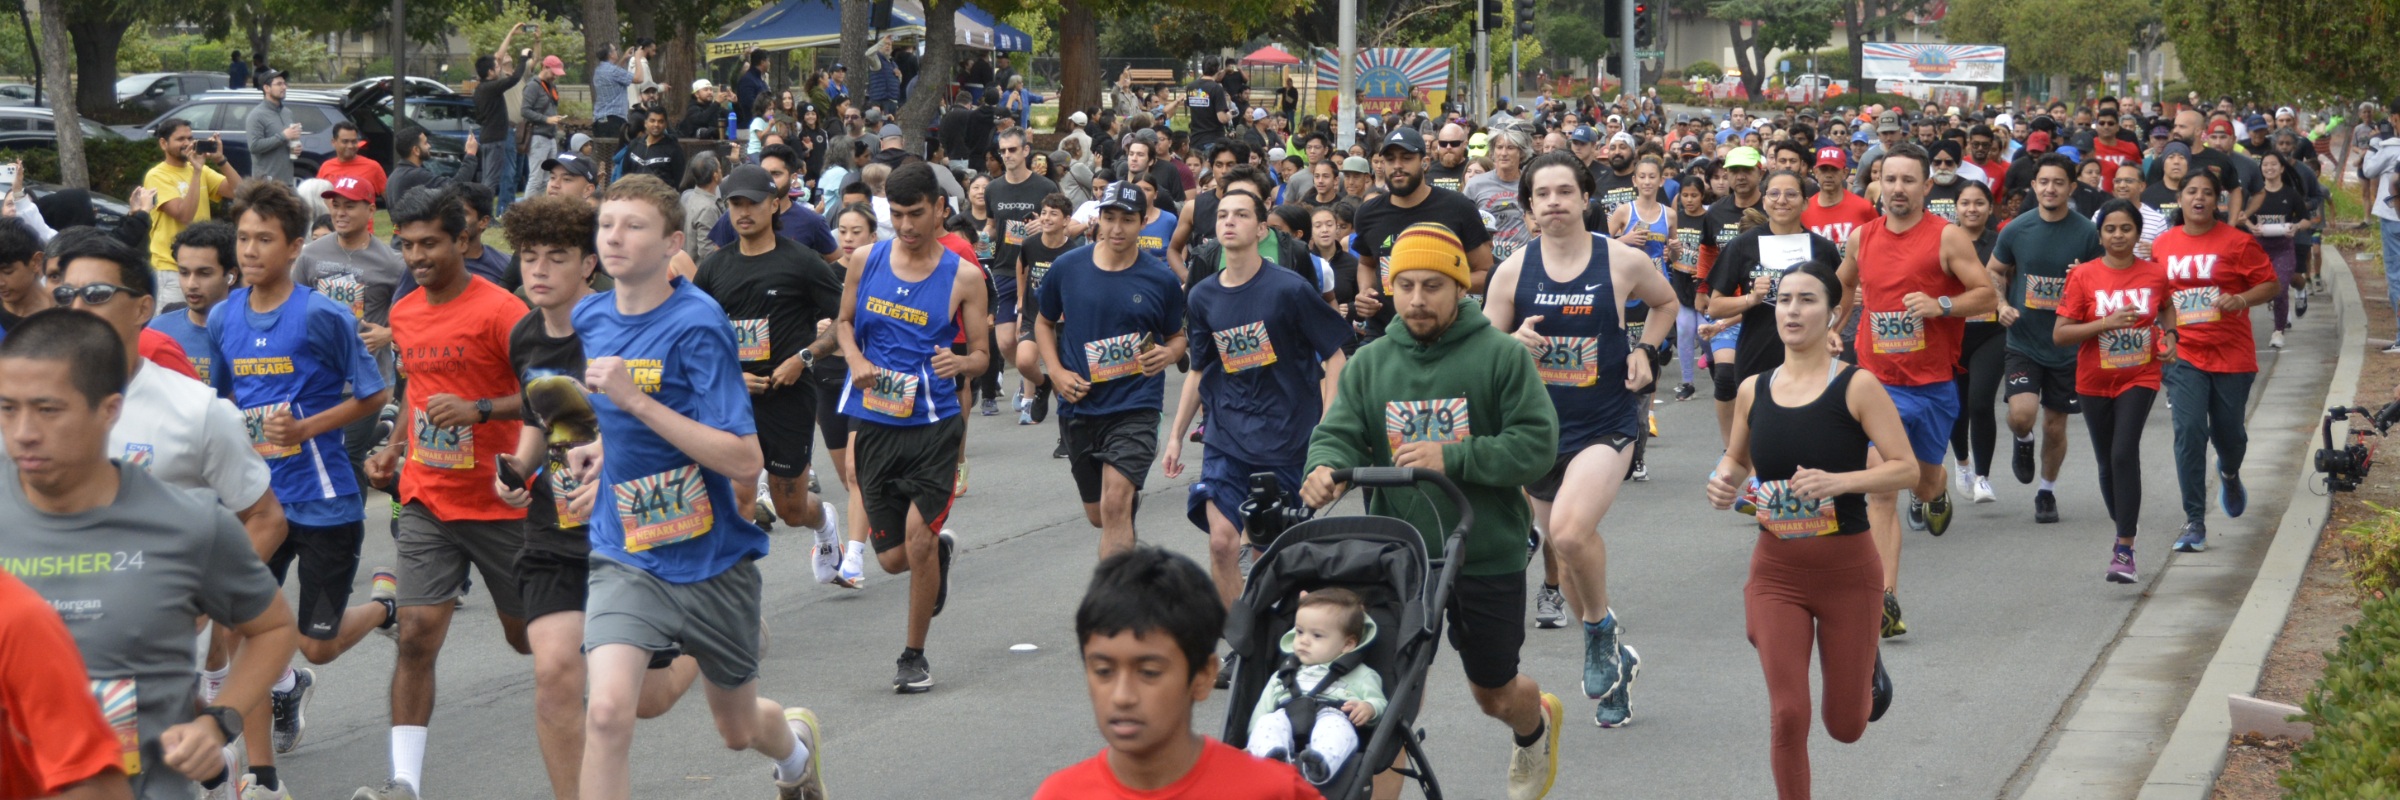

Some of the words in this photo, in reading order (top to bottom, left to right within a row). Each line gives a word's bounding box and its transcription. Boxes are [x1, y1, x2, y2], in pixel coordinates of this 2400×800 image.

[1967, 62, 1995, 71] FINISH
[1970, 70, 1990, 79] LINE
[1363, 101, 1392, 110] WARK
[997, 202, 1035, 211] Shopagon
[1011, 225, 1029, 236] 46
[1811, 222, 1853, 243] MV
[1491, 244, 1512, 257] 08
[2167, 254, 2217, 280] MV
[325, 285, 355, 303] 188
[2033, 281, 2064, 297] 437
[1534, 293, 1595, 306] ILLINOIS
[2095, 287, 2152, 316] MV
[2179, 291, 2211, 310] 276
[866, 301, 928, 327] COUGARS
[868, 296, 894, 310] NEWARK
[894, 302, 929, 318] MEMORIAL
[1562, 305, 1593, 315] ELITE
[1878, 316, 1914, 336] 556
[735, 324, 758, 345] 01
[1222, 329, 1260, 354] 265
[1878, 340, 1902, 348] NEWARK
[1902, 339, 1917, 347] MILE
[2108, 332, 2142, 352] 280
[404, 346, 464, 357] RUNAY
[748, 348, 763, 357] MILE
[1095, 340, 1133, 364] 268
[1539, 343, 1582, 365] 251
[2108, 355, 2132, 363] NEWARK
[2132, 353, 2145, 361] MILE
[233, 357, 260, 365] NEWARK
[261, 356, 291, 364] MEMORIAL
[405, 360, 467, 372] UNDATION
[624, 358, 663, 368] MORIAL
[1229, 356, 1253, 367] NEWARK
[1253, 353, 1267, 363] MILE
[234, 362, 294, 376] COUGARS
[1098, 365, 1124, 377] NEWARK
[1124, 362, 1137, 371] MILE
[1538, 369, 1568, 380] NEWARK
[1569, 370, 1587, 380] MILE
[867, 398, 889, 410] NEWARK
[890, 402, 905, 411] MILE
[1399, 407, 1454, 437] 379
[418, 417, 460, 446] 273
[418, 448, 444, 461] NEWARK
[444, 452, 464, 462] MILE
[632, 477, 685, 518] 447
[637, 523, 676, 541] NEWARK
[677, 516, 702, 534] MILE
[1768, 520, 1804, 532] NEWARK
[1804, 519, 1826, 529] MILE
[0, 552, 113, 577] INISHER
[113, 550, 146, 572] 24
